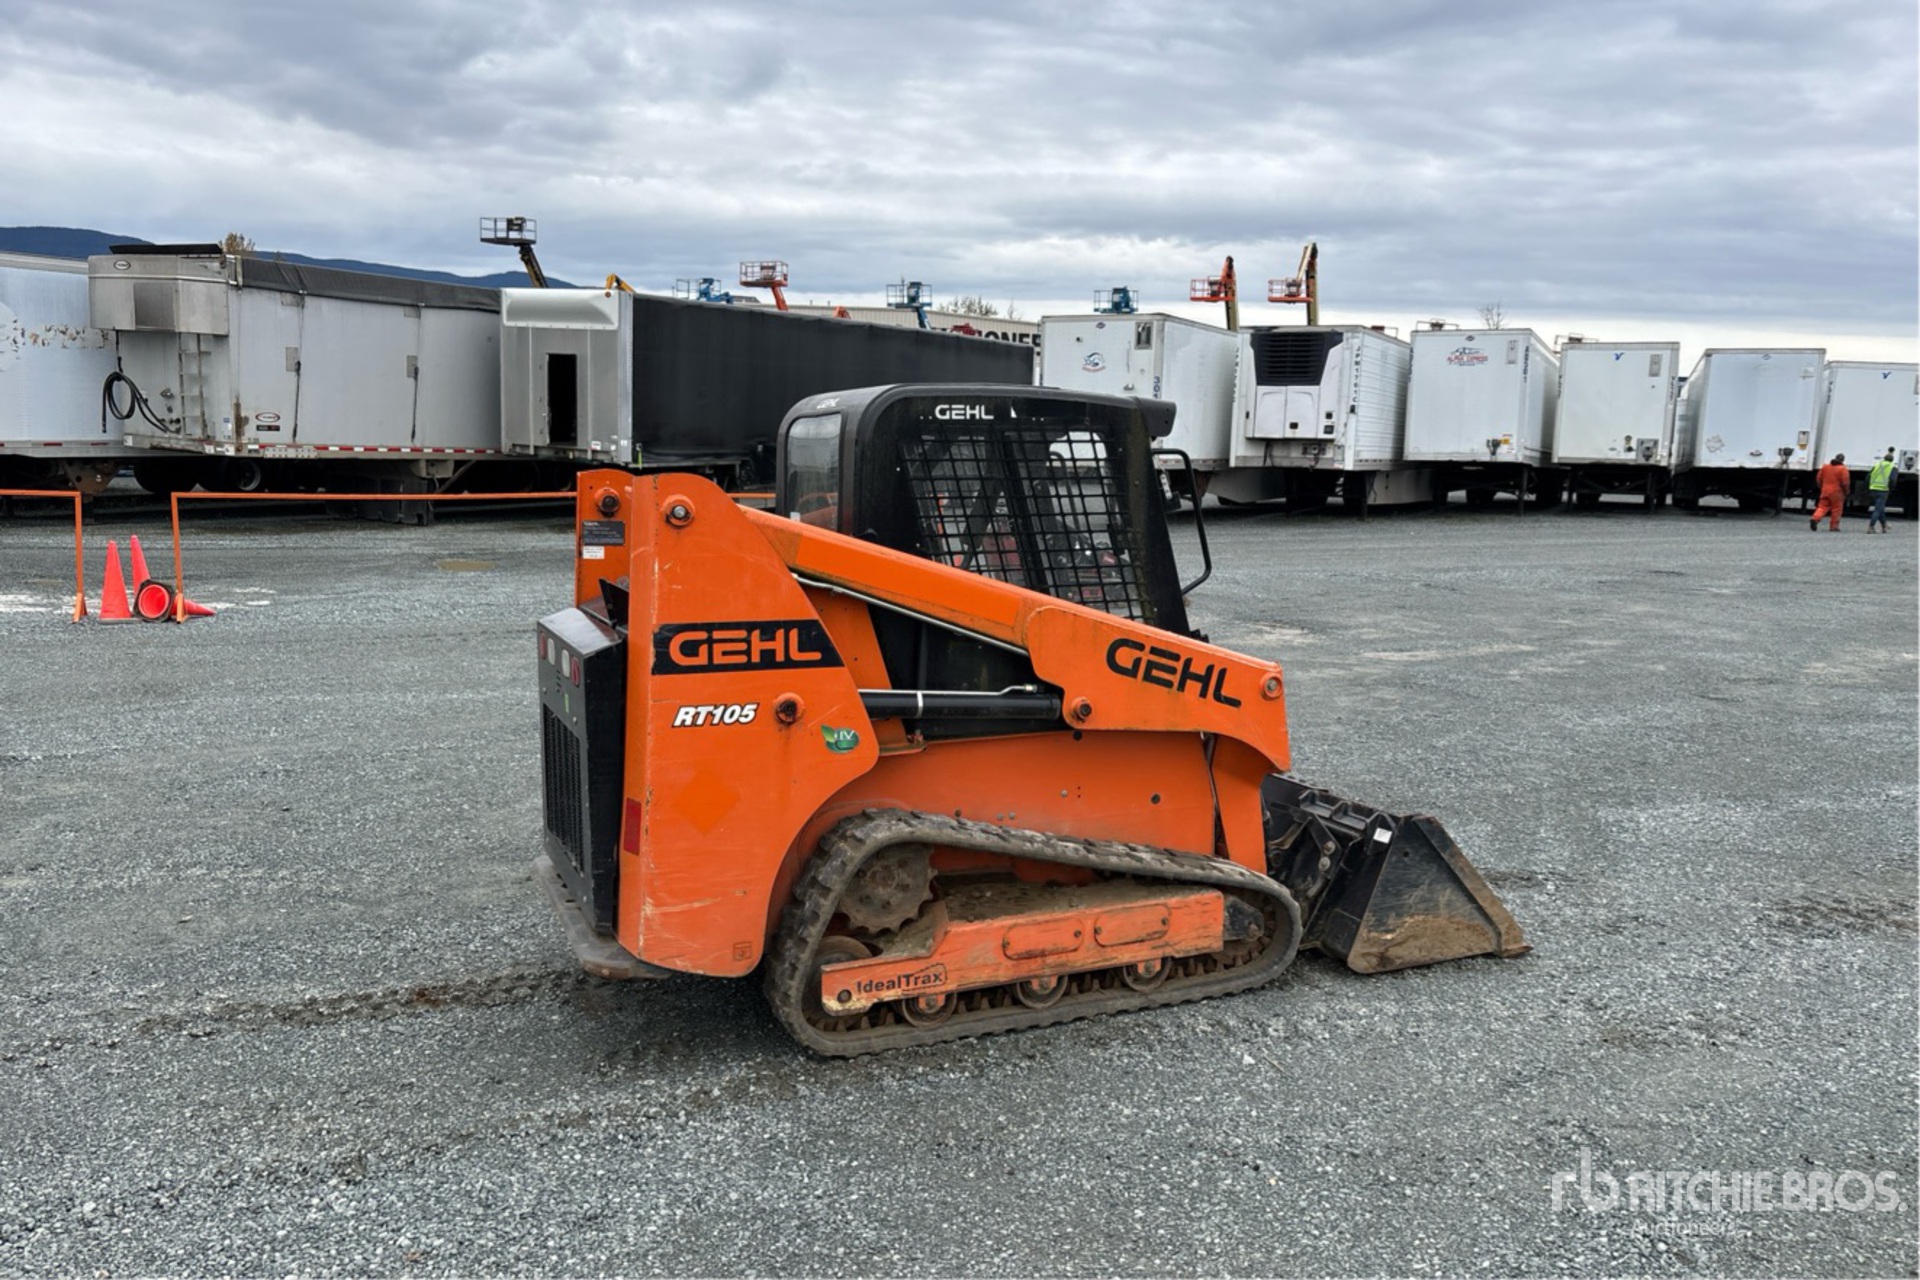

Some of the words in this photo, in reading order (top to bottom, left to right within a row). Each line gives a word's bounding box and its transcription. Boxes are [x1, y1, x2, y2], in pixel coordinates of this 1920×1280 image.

[934, 404, 994, 420] GEHL
[668, 627, 823, 667] GEHL
[1105, 637, 1243, 709] GEHL
[672, 702, 760, 728] RT105
[856, 972, 943, 995] IdealTrax
